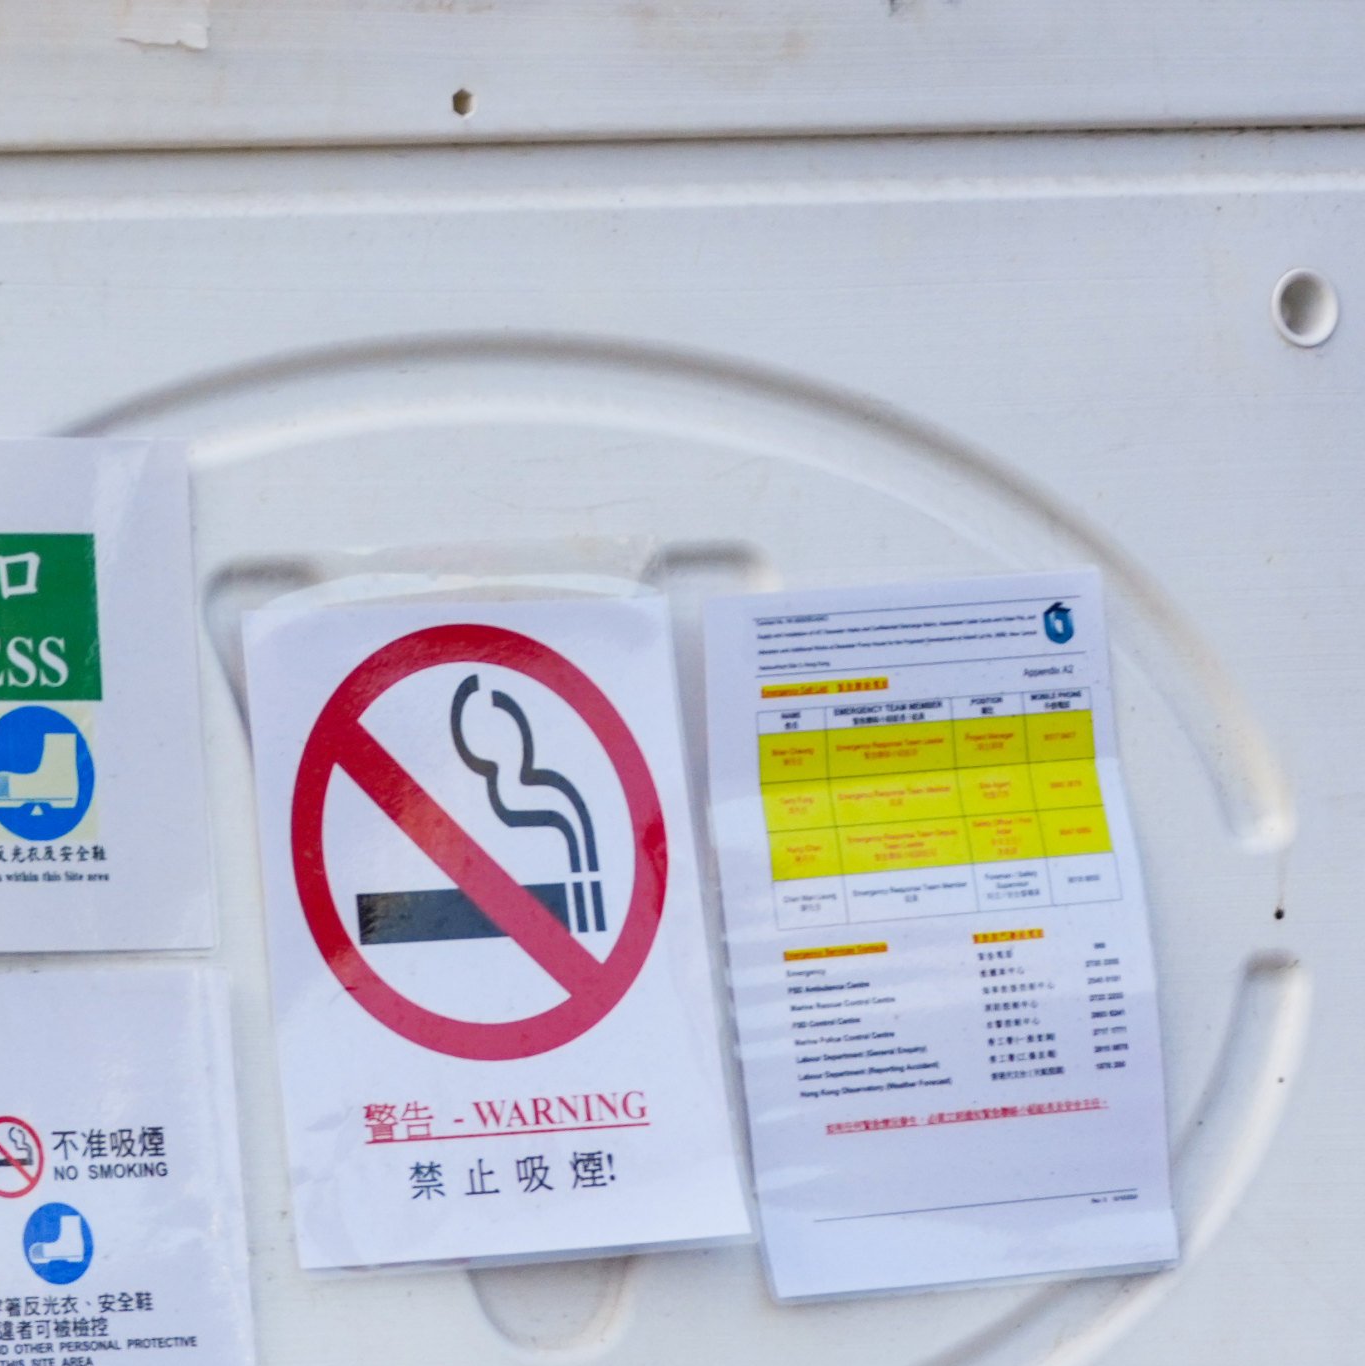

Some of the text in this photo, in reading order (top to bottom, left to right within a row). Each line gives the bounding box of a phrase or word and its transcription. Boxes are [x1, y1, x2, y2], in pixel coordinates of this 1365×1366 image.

[834, 705, 883, 717] EMERGENCY
[886, 703, 907, 712] TEAM
[6, 870, 39, 882] within
[42, 870, 61, 881] this
[87, 872, 109, 881] area
[786, 968, 826, 978] Emergency
[363, 1102, 434, 1141] 警告
[471, 1090, 648, 1129] WARNING
[51, 1126, 166, 1160] 不准吸煙
[53, 1161, 168, 1181] NO SMOKING
[409, 1150, 616, 1200] 禁止吸煙!
[14, 1342, 54, 1355] OTHER
[60, 1339, 121, 1352] PERSONAL
[127, 1335, 198, 1349] PROTECTIVE
